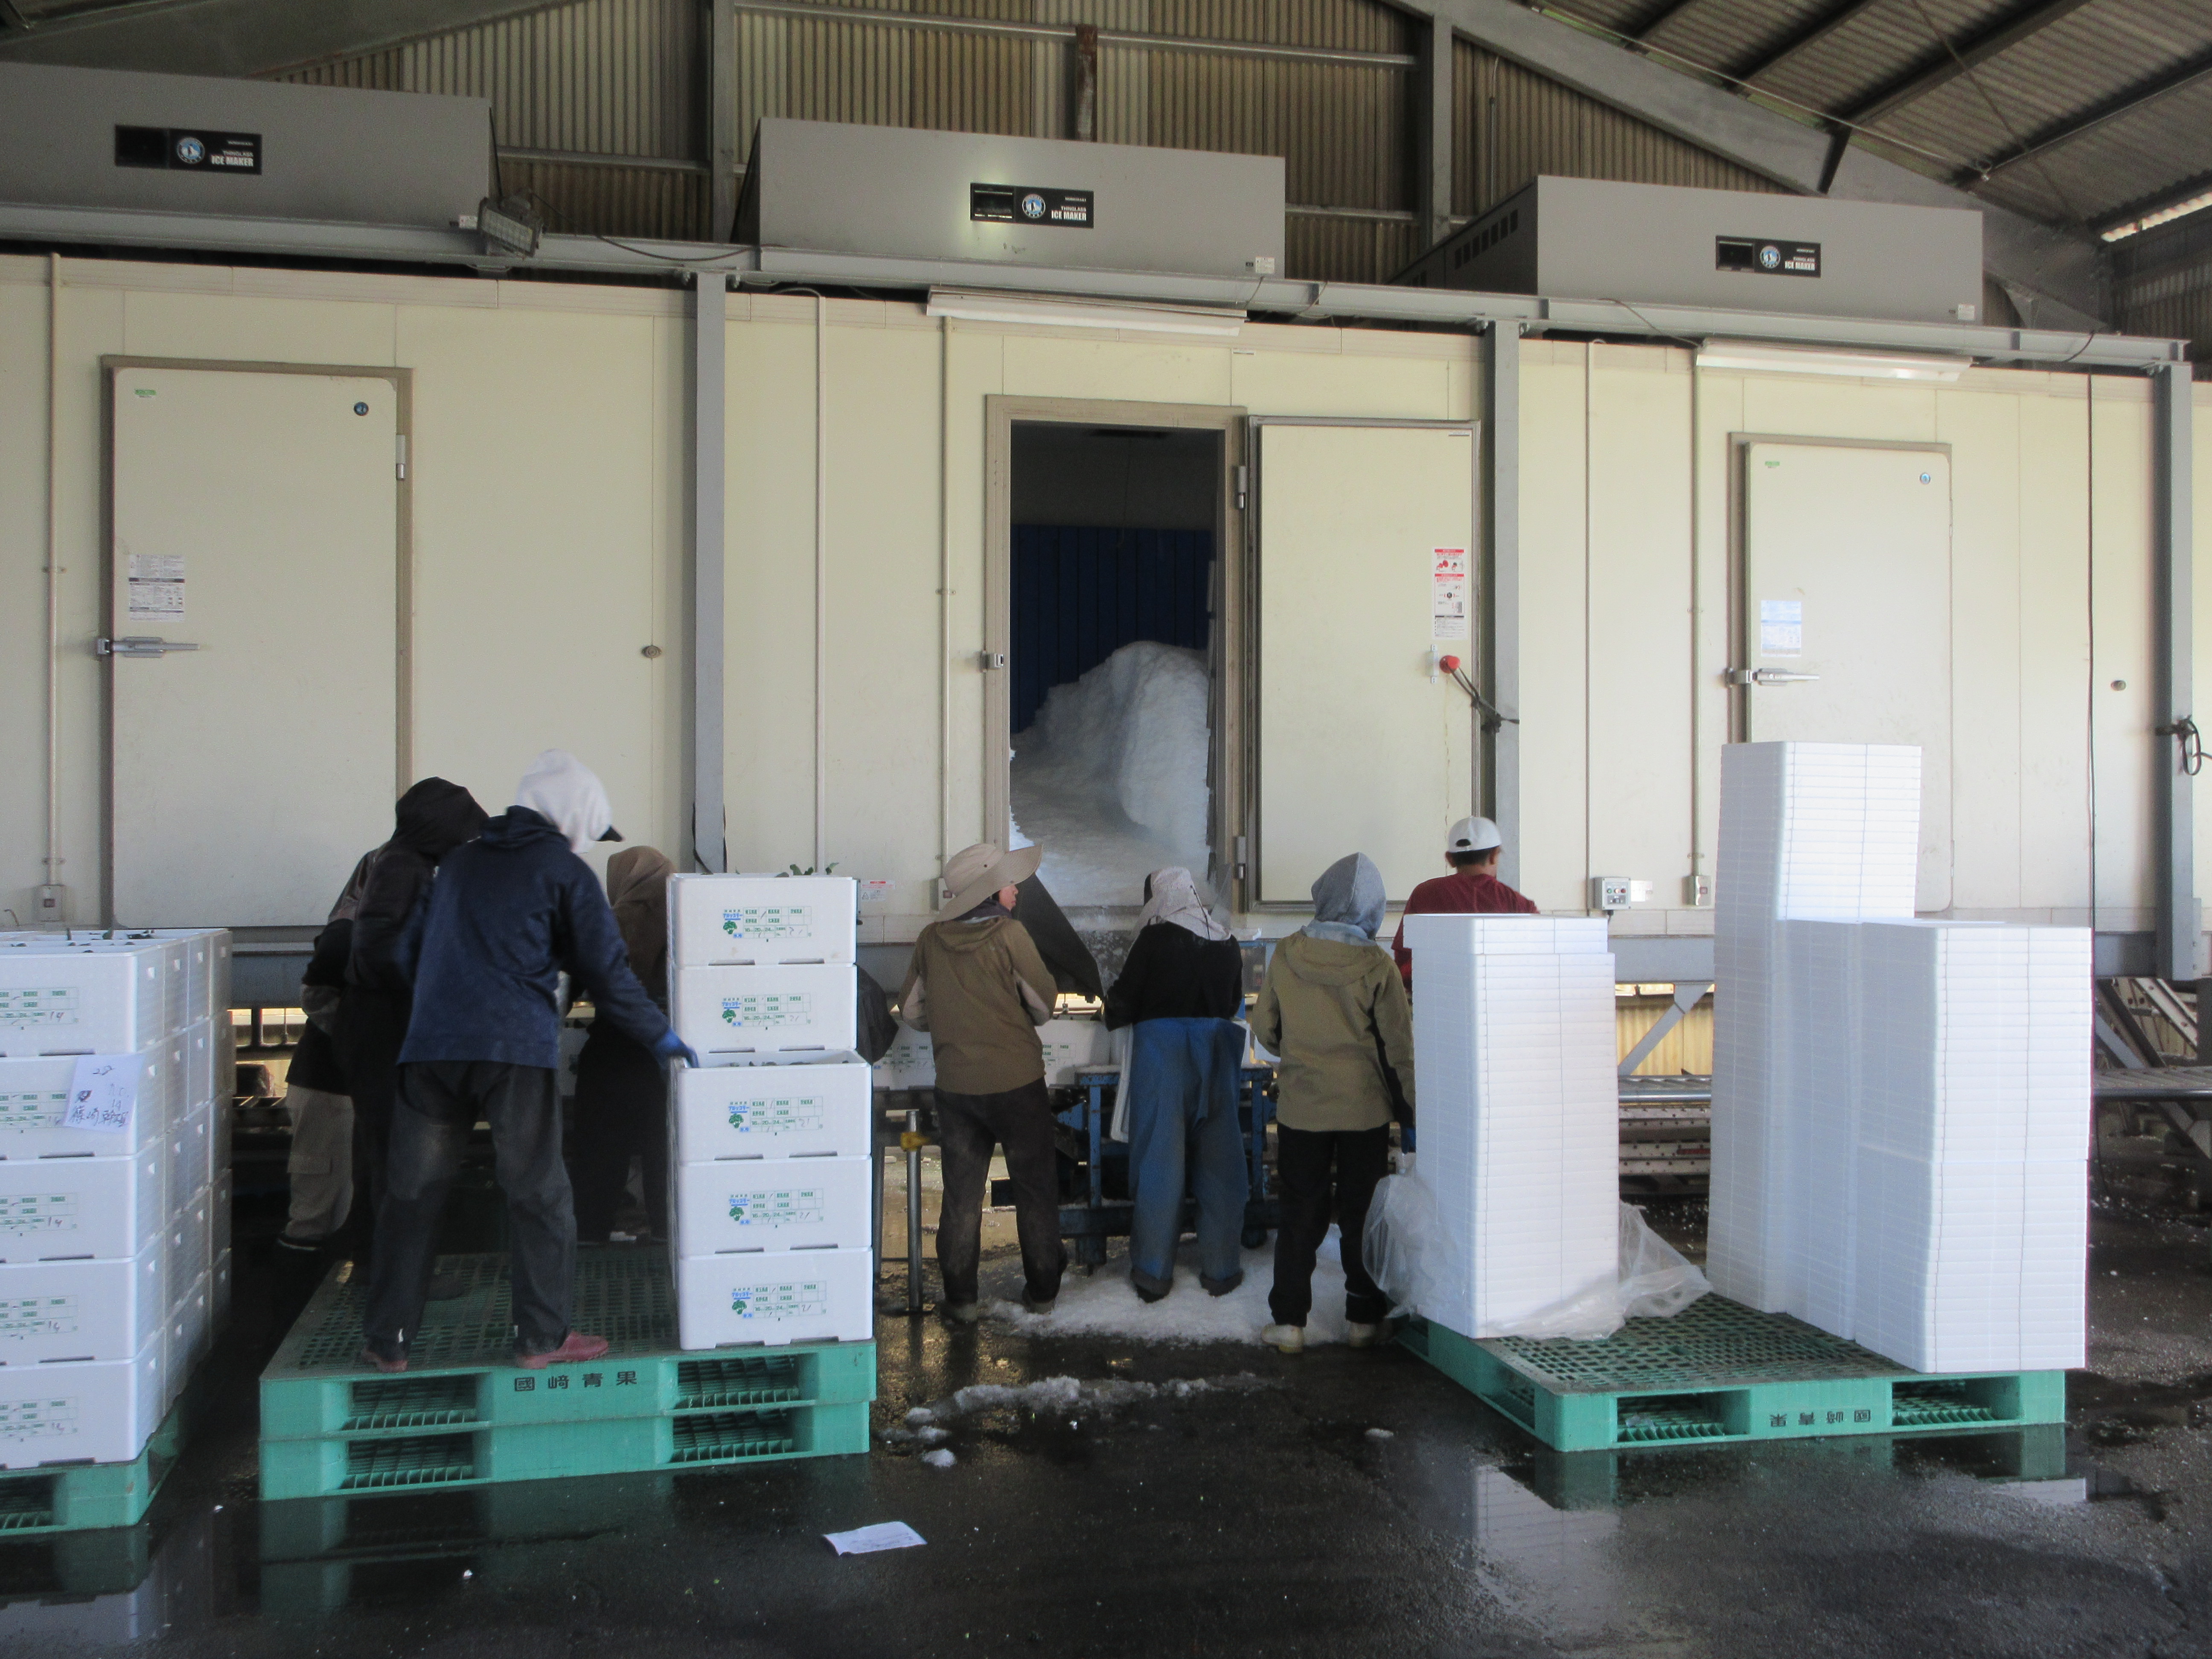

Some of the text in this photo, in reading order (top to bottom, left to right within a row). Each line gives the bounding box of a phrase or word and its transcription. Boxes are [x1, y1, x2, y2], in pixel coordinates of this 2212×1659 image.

[211, 155, 253, 167] ICE MAKER
[1051, 210, 1087, 221] ICE MAKER
